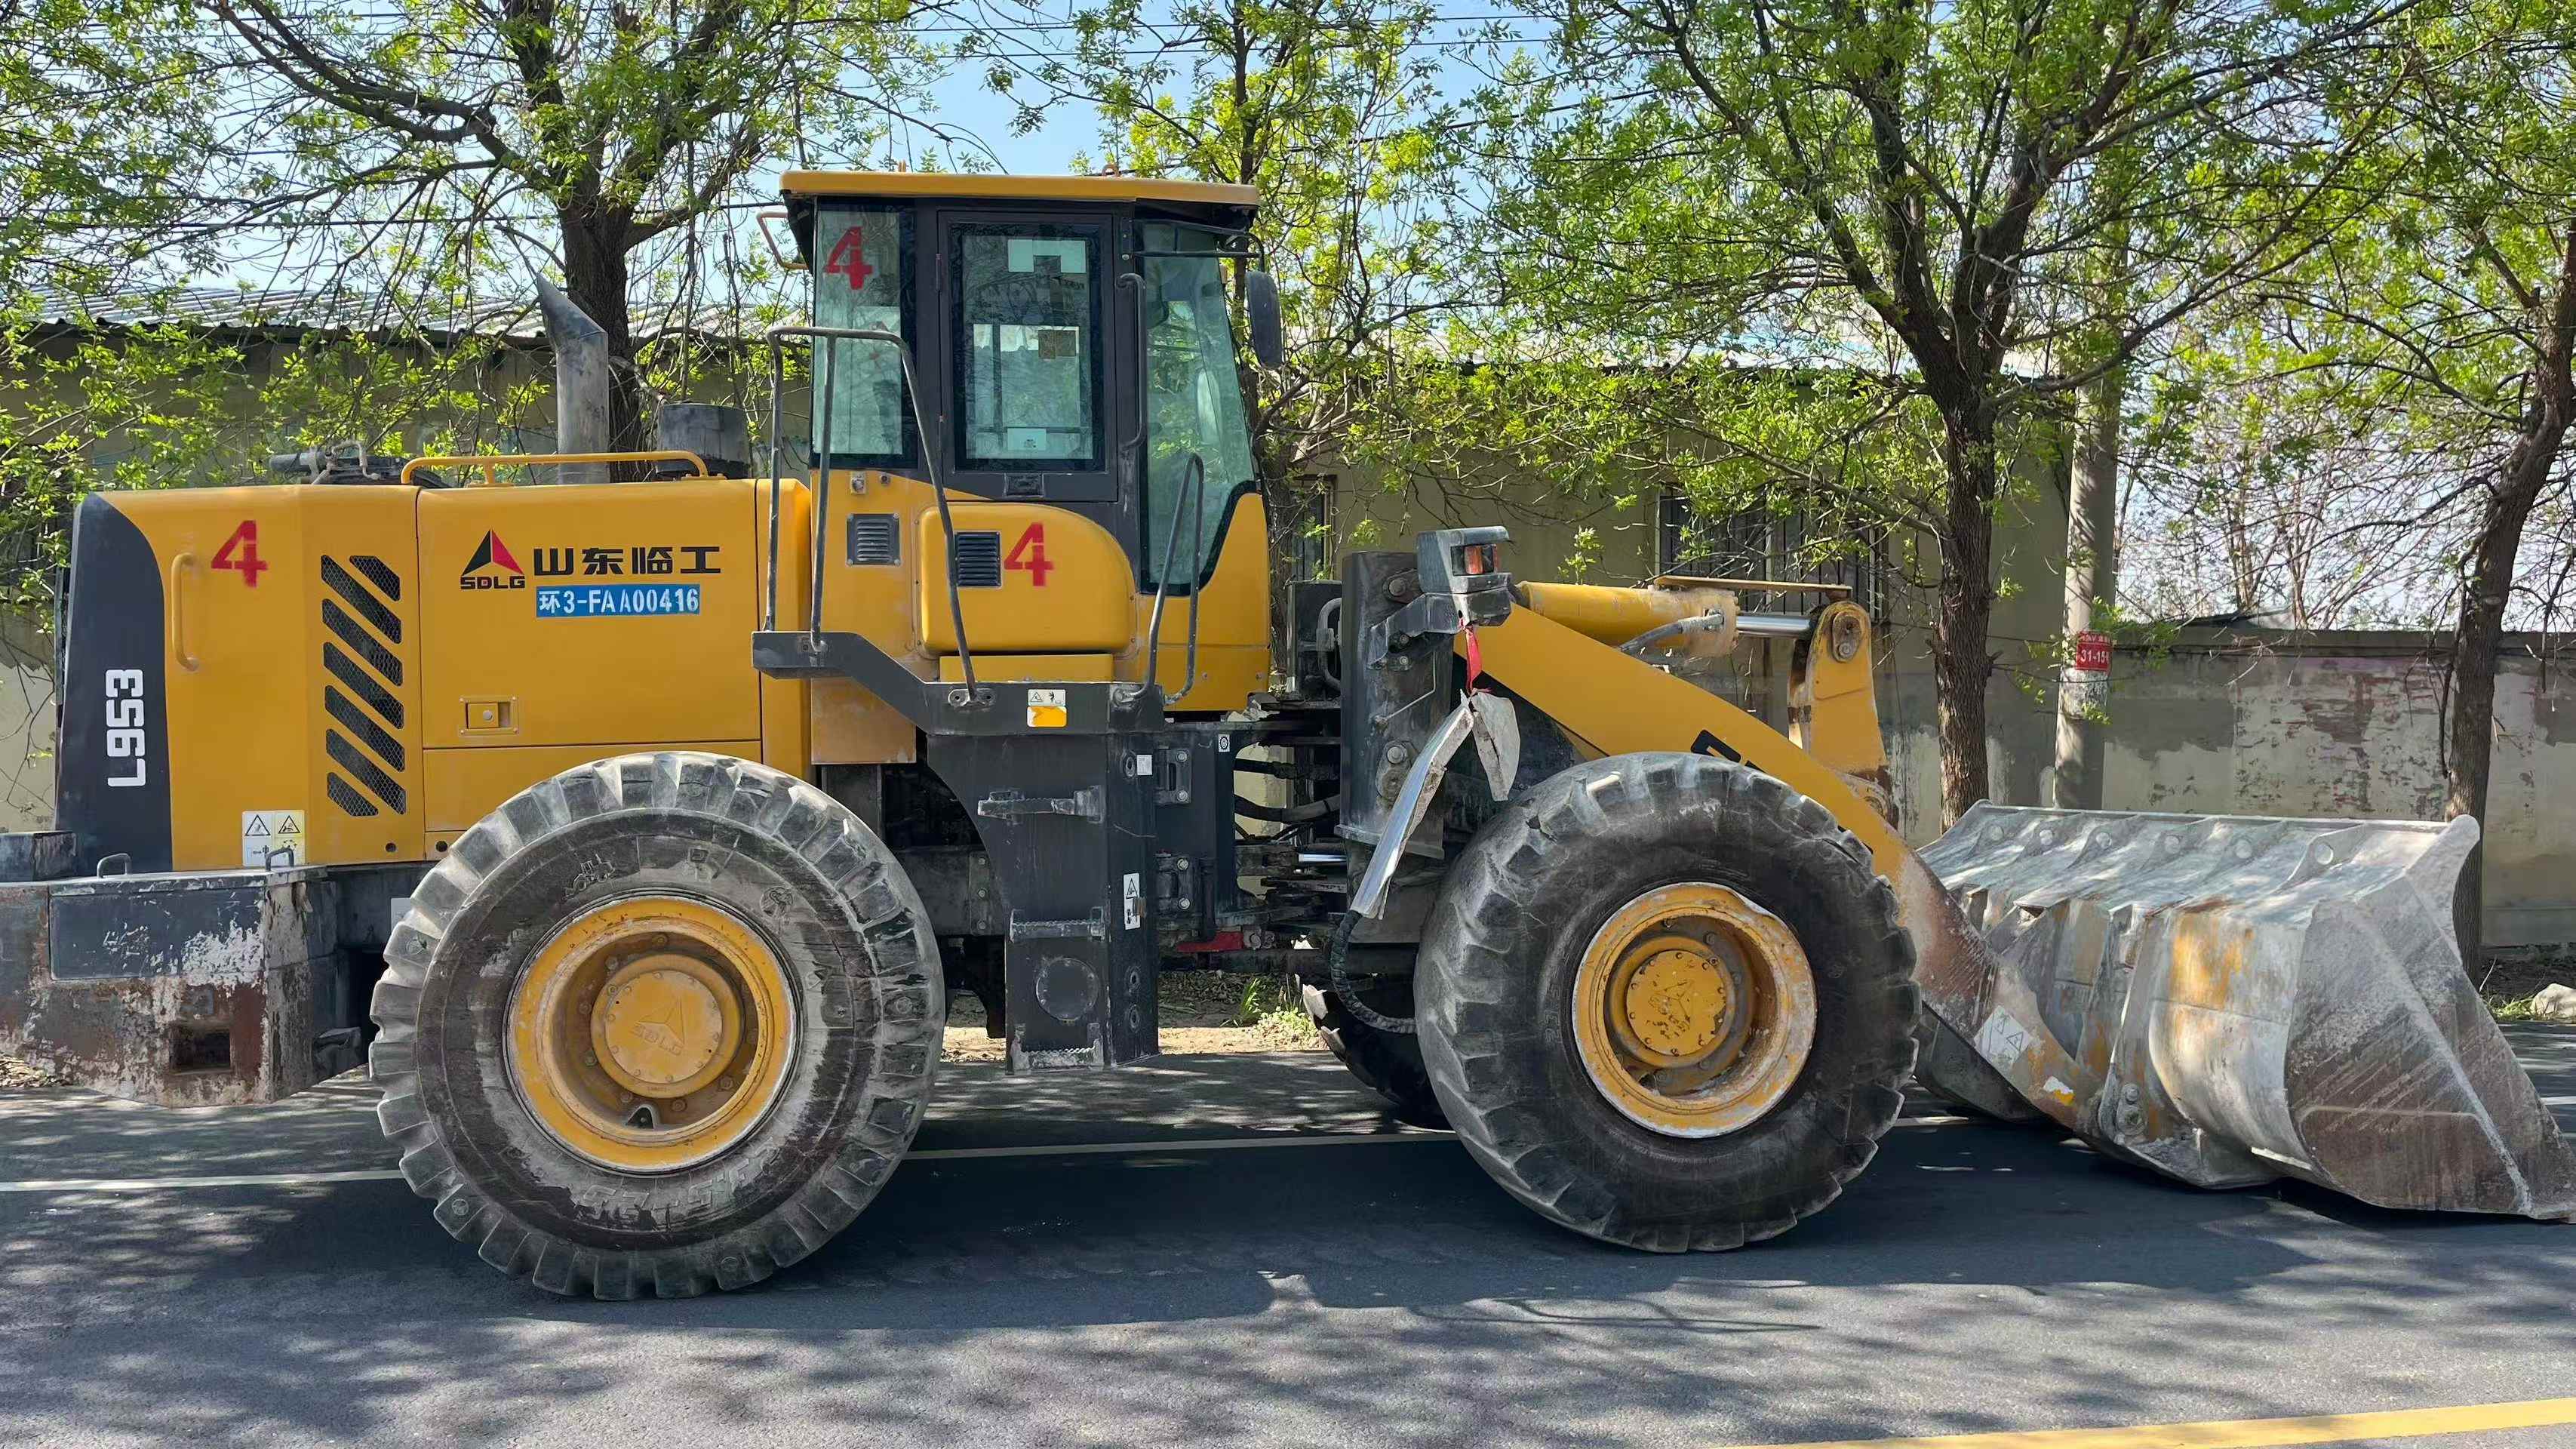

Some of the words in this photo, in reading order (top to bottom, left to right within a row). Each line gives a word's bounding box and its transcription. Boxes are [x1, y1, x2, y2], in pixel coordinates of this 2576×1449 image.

[824, 226, 873, 290] 4
[211, 520, 267, 588] 4
[460, 576, 525, 590] SDLG
[533, 546, 721, 576] 山东临工
[1004, 522, 1053, 586] 4
[539, 589, 699, 614] 环3-FAA00416
[106, 669, 146, 786] L953
